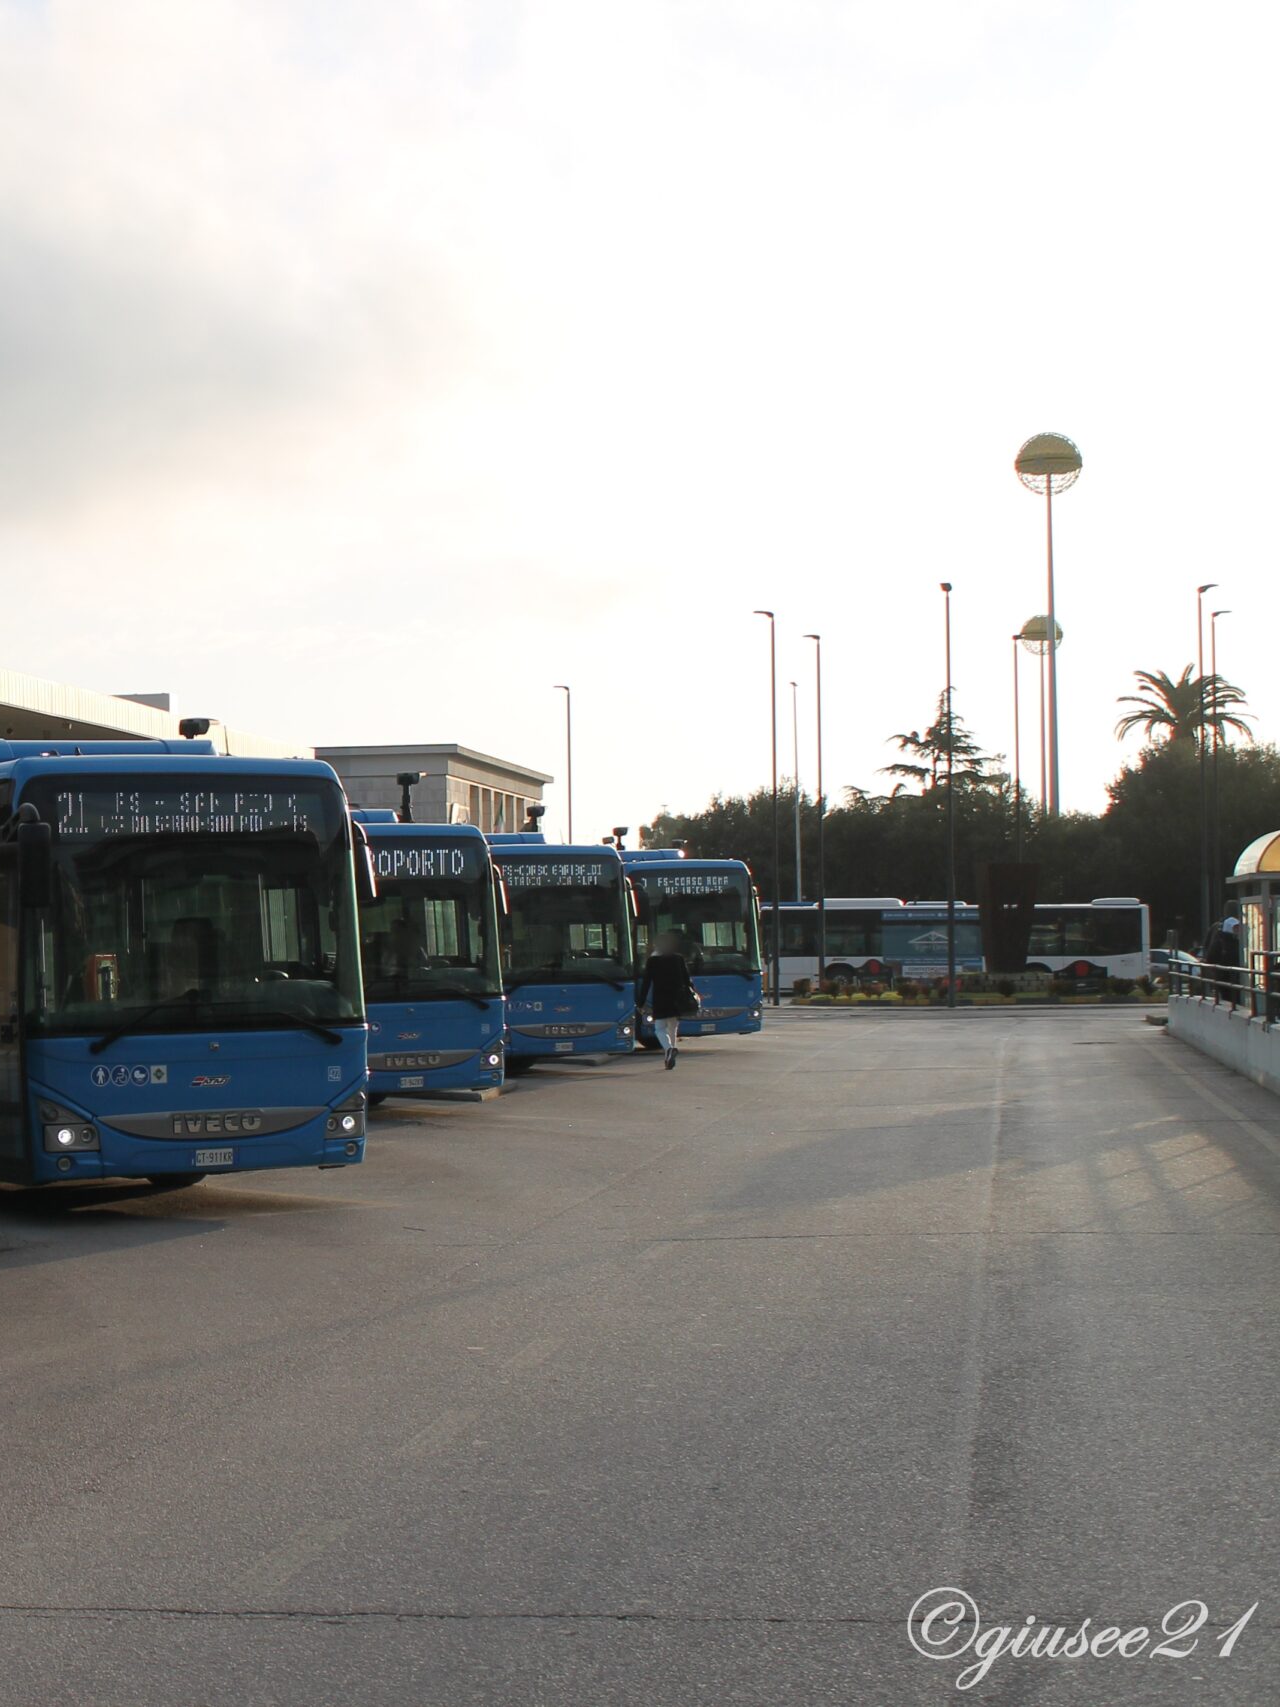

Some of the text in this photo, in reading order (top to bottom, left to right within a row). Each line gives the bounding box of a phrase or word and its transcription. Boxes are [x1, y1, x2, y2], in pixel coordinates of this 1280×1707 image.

[58, 792, 89, 833] 21
[385, 1054, 440, 1068] IVECO
[172, 1112, 262, 1135] IVECO
